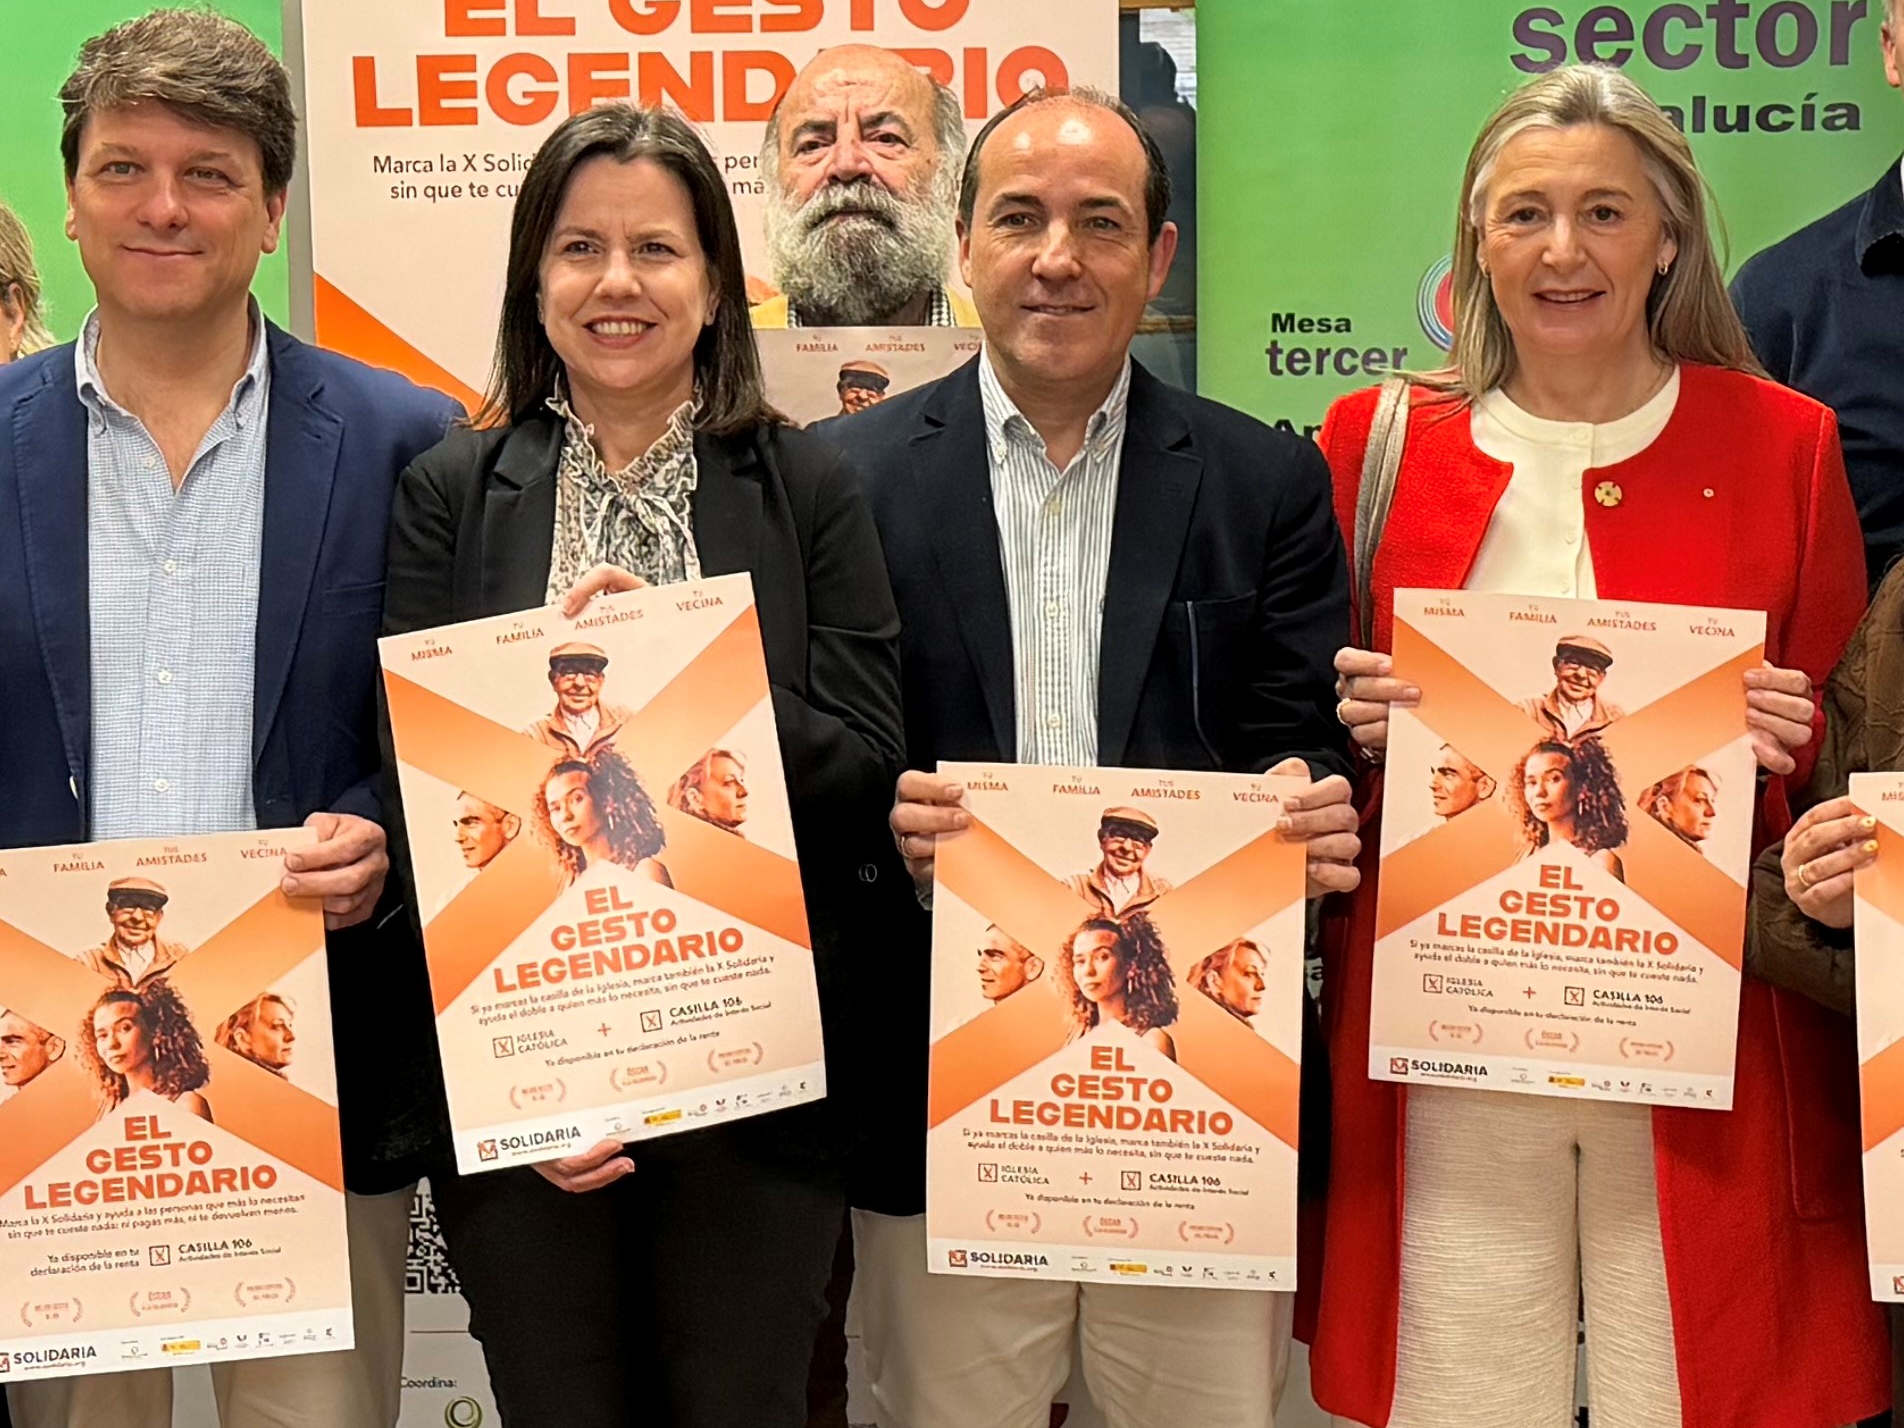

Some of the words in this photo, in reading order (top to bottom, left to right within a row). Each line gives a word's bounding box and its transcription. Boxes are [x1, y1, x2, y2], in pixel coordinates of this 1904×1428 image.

[352, 46, 1068, 128] LEGENDIO
[373, 155, 433, 173] Marca
[440, 153, 456, 172] la
[462, 153, 477, 172] X
[390, 180, 417, 199] sin
[423, 184, 462, 203] que
[468, 182, 489, 197] te
[1272, 313, 1351, 333] Mesa
[1265, 340, 1408, 376] tercer
[1508, 611, 1557, 623] FAMILIA
[494, 627, 544, 645] FAMILIA
[1052, 784, 1100, 795] FAMILIA
[53, 860, 103, 873] FAMILIA
[1540, 865, 1583, 889] EL
[585, 884, 631, 914] EL
[1499, 890, 1619, 921] GESTO
[550, 907, 676, 951] GESTO
[1438, 913, 1678, 955] LEGENDARIO
[494, 926, 744, 992] LEGENDARIO
[1091, 1046, 1134, 1070] EL
[1411, 1059, 1488, 1077] SOLIDARIA
[1052, 1074, 1172, 1102] GESTO
[124, 1115, 170, 1140] EL
[991, 1099, 1232, 1135] LEGENDARIO
[499, 1126, 581, 1151] SOLIDARIA
[86, 1140, 212, 1173] GESTO
[24, 1164, 277, 1209] LEGENDARIO
[178, 1240, 229, 1254] CASILLA
[232, 1237, 252, 1249] 106
[970, 1251, 1048, 1267] SOLIDARIA
[13, 1346, 97, 1365] SOLIDARIA
